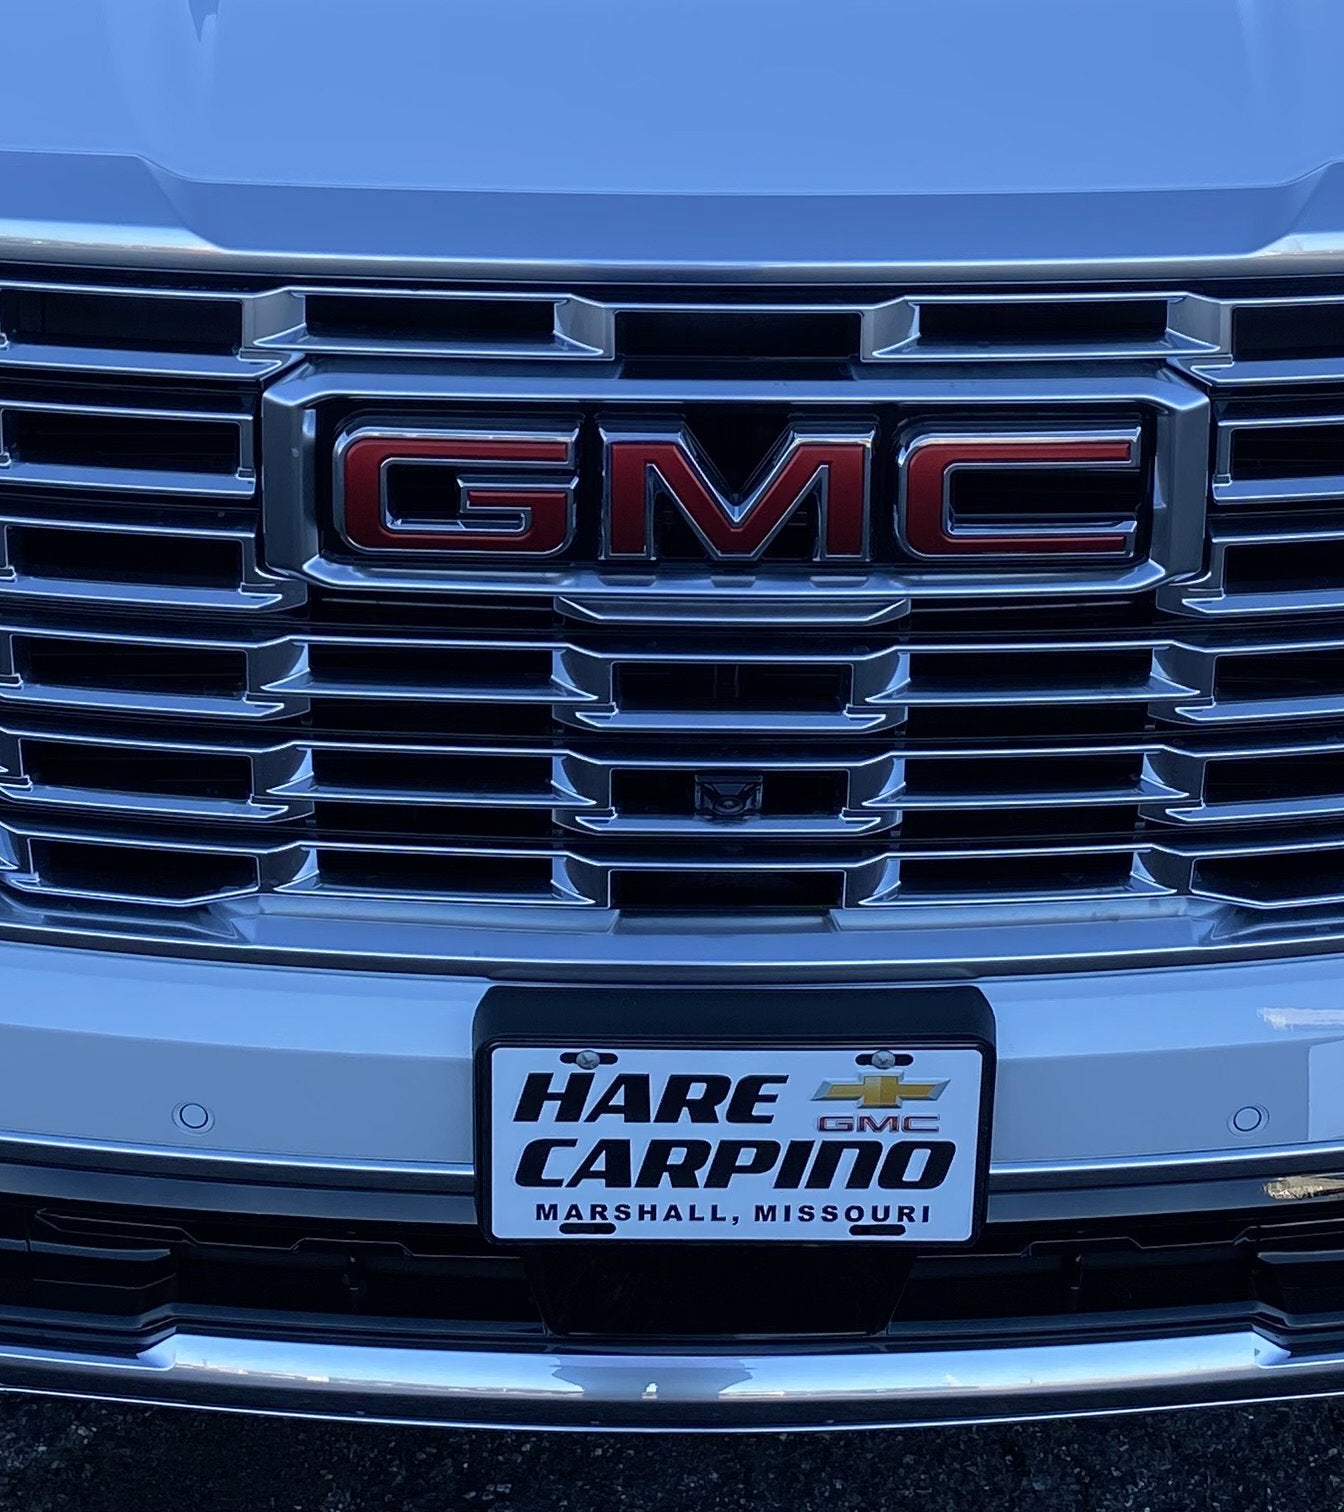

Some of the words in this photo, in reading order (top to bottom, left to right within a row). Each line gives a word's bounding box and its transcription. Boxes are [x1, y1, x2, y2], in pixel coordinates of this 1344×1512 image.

[332, 420, 1141, 562] GMC
[513, 1071, 790, 1124] HARE
[816, 1112, 942, 1134] GMC
[513, 1137, 957, 1190] CARPINO
[535, 1203, 741, 1226] MARSHALL,
[754, 1204, 932, 1224] MISSOURI
